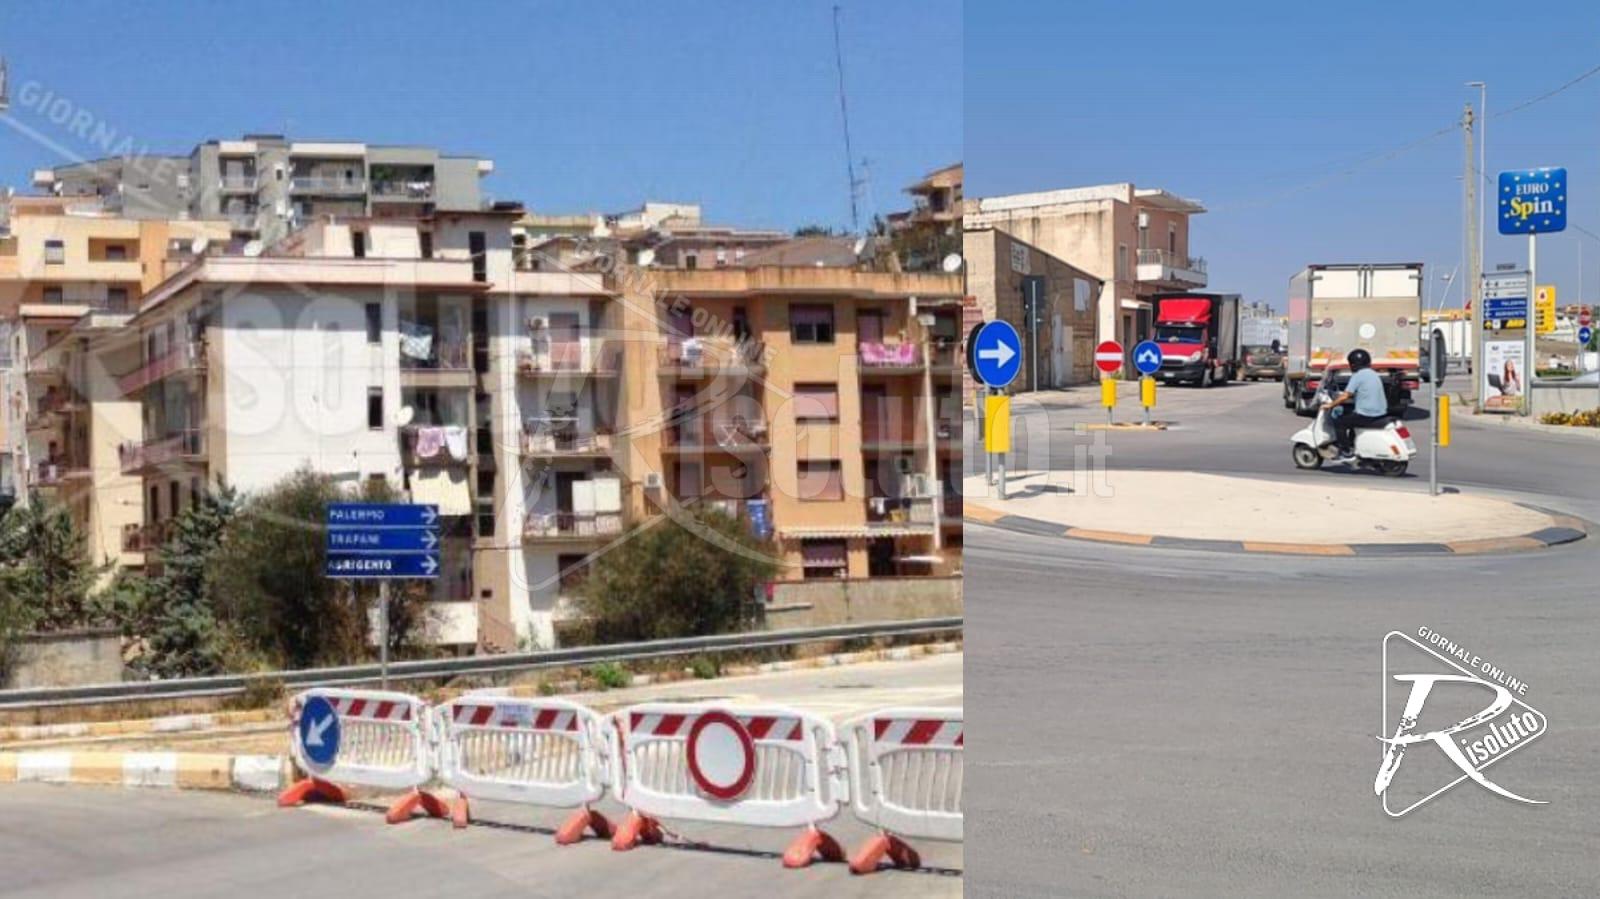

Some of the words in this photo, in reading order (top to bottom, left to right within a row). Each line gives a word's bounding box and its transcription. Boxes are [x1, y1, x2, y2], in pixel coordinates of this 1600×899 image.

[1515, 182, 1550, 196] EURO
[1509, 196, 1554, 220] Spin
[329, 509, 385, 521] PALERMO
[330, 533, 380, 545] TRAPANI
